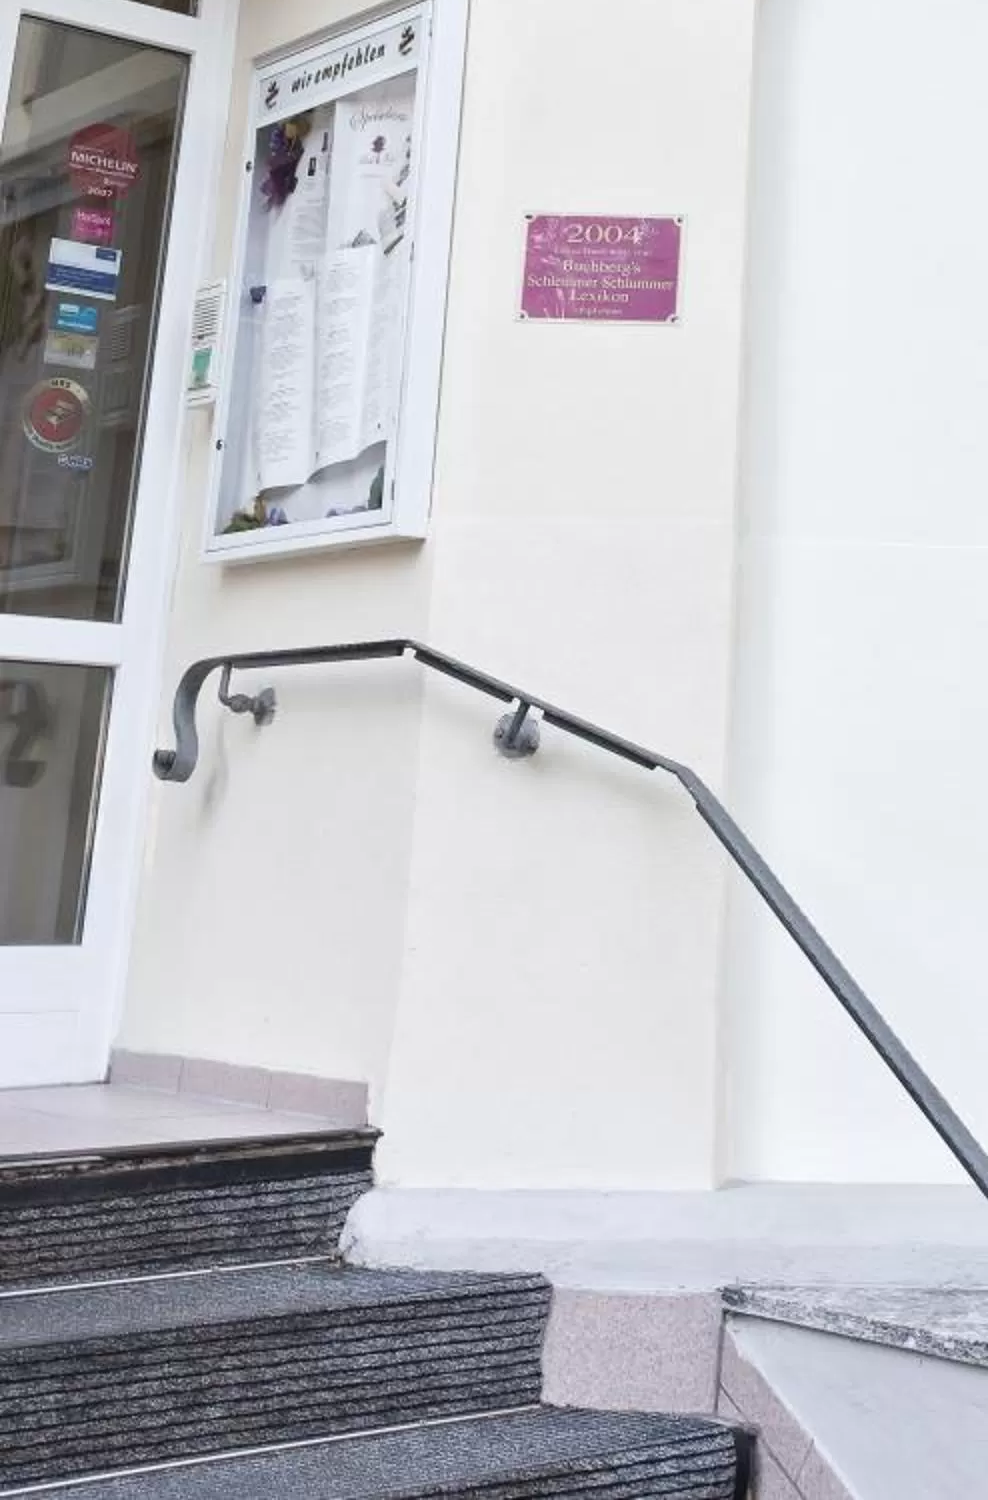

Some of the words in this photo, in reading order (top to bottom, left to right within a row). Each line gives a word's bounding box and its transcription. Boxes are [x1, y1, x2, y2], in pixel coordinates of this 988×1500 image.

[291, 70, 312, 93] wir
[313, 43, 386, 83] empfehlen
[70, 150, 138, 174] MICHELIN
[566, 223, 643, 245] 2004
